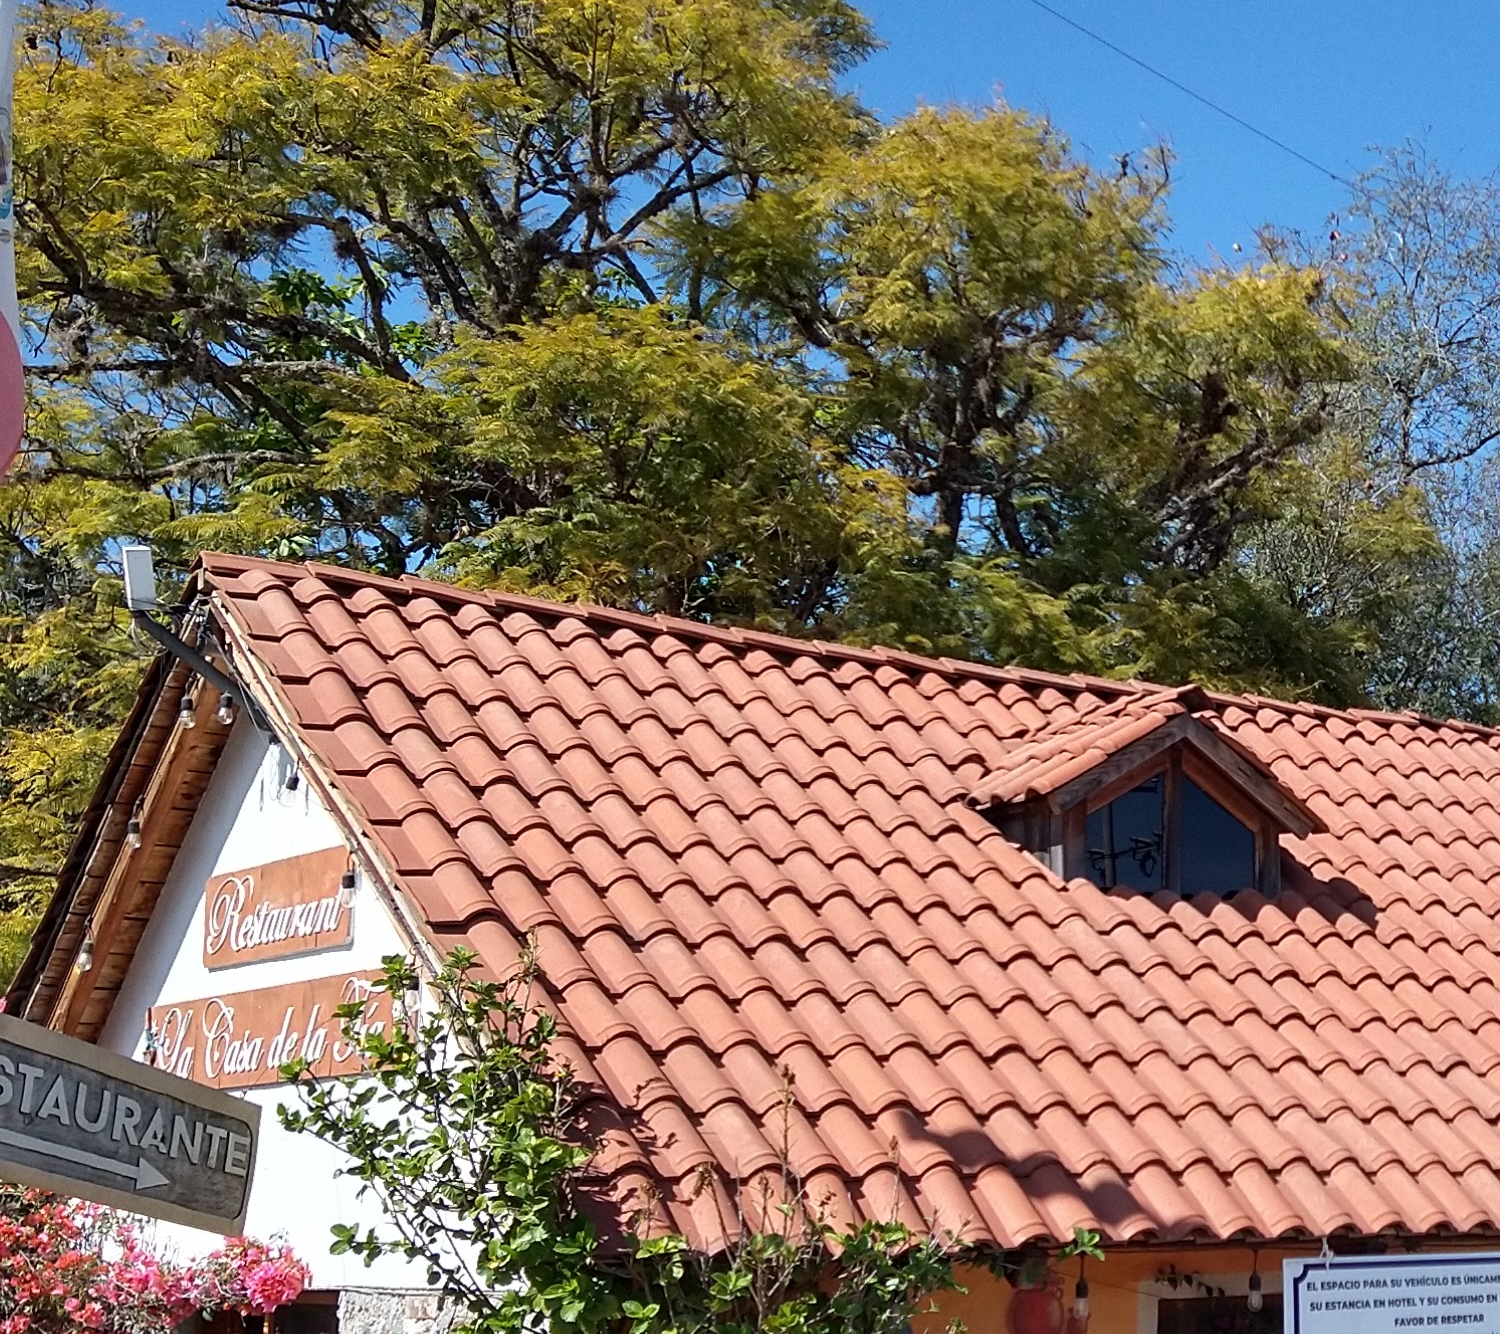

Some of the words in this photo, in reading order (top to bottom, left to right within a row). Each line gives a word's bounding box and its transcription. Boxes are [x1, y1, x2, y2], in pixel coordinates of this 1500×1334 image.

[207, 875, 344, 955] Restaurant
[156, 1007, 195, 1080] La
[203, 998, 264, 1079] Casa
[267, 1007, 299, 1066] de
[302, 1005, 329, 1063] la
[1306, 1282, 1318, 1291] EL
[1320, 1280, 1361, 1291] ESPACIO
[1363, 1279, 1389, 1289] PARA
[1390, 1278, 1402, 1288] SU
[1404, 1275, 1449, 1287] VEHÍCULO
[1451, 1276, 1462, 1286] ES
[1310, 1302, 1323, 1312] SU
[1325, 1300, 1371, 1311] ESTANCIA
[1373, 1299, 1386, 1309] EN
[1387, 1298, 1417, 1308] HOTEL
[1419, 1297, 1426, 1306] Y
[1427, 1296, 1439, 1306] SU
[1441, 1295, 1485, 1305] CONSUMO
[1486, 1293, 1498, 1303] EN
[1394, 1317, 1425, 1327] FAVOR
[1426, 1316, 1439, 1325] DE
[1441, 1314, 1485, 1325] RESPETAR
